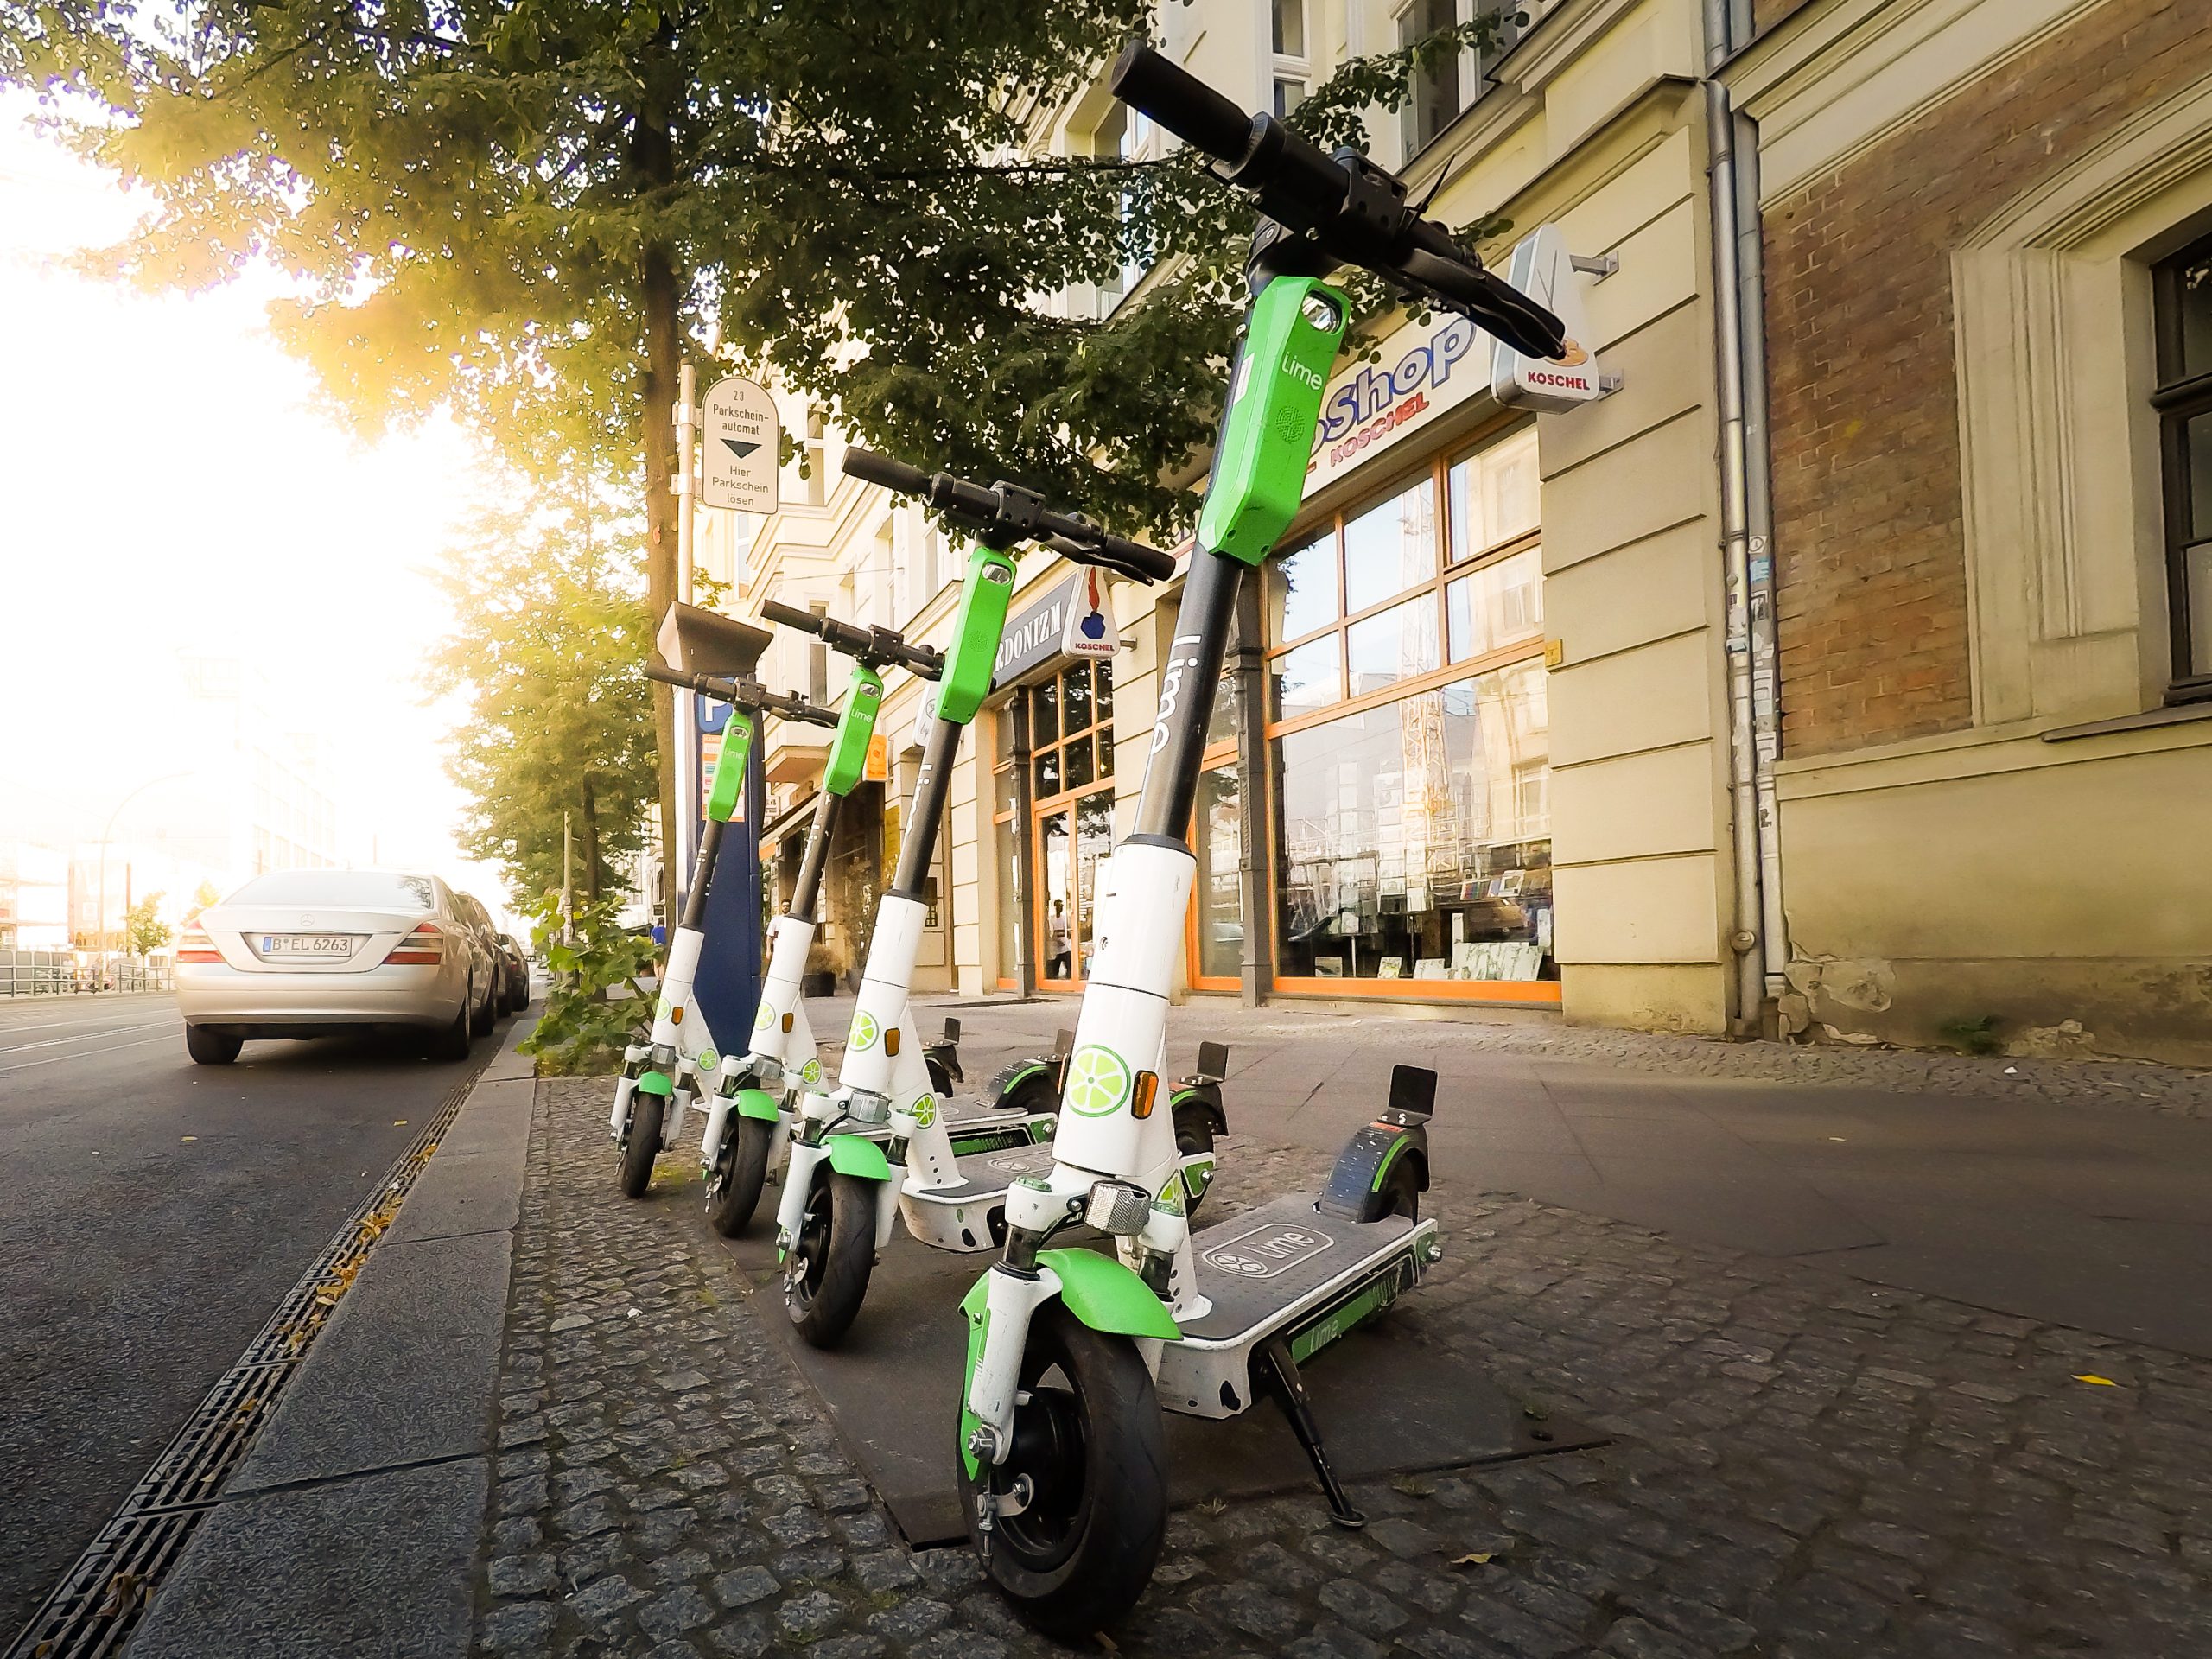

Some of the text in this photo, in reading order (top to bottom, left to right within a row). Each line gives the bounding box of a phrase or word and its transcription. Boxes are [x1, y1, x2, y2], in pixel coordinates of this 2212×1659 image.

[1281, 351, 1323, 391] Lime
[1528, 370, 1591, 391] KOSCHEL
[733, 390, 745, 402] 23
[713, 403, 769, 423] Parkschein-
[721, 421, 760, 435] automat
[1330, 391, 1430, 467] KOSCHEL
[730, 465, 752, 478] Hier
[712, 476, 769, 493] Parkschein
[727, 493, 754, 506] lösen
[1075, 642, 1115, 652] KOSCHEL
[850, 708, 873, 723] Lime
[272, 938, 348, 951] B EL 6263
[1242, 1231, 1315, 1260] Lime
